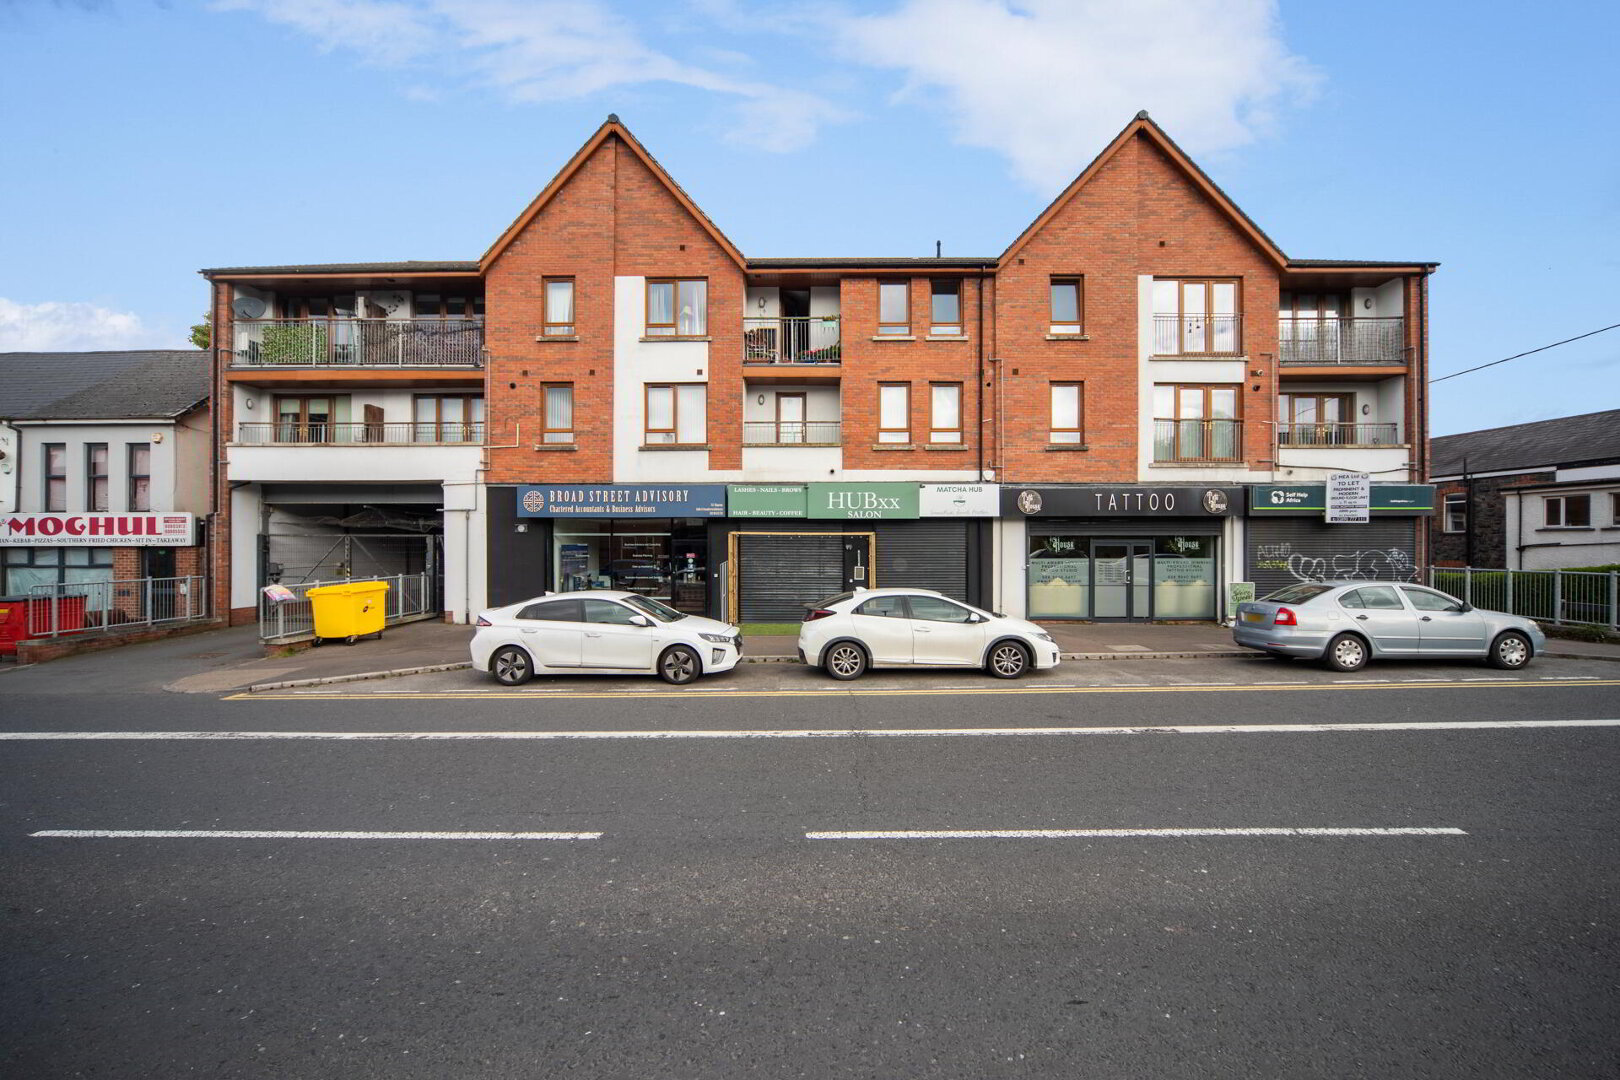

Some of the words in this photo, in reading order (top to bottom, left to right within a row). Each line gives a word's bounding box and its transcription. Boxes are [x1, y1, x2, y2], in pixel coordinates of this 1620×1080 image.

[550, 490, 584, 502] BROAD
[589, 490, 630, 502] STREET
[635, 490, 689, 502] ADVISORY
[826, 491, 900, 510] HUBxx
[1095, 493, 1175, 511] TATTOO
[549, 504, 574, 513] Chartered
[575, 504, 604, 513] Accountants
[605, 504, 611, 513] &
[612, 504, 633, 513] Business
[634, 504, 656, 513] Advisors
[847, 510, 882, 519] SALON
[8, 516, 162, 536] MOGHUL
